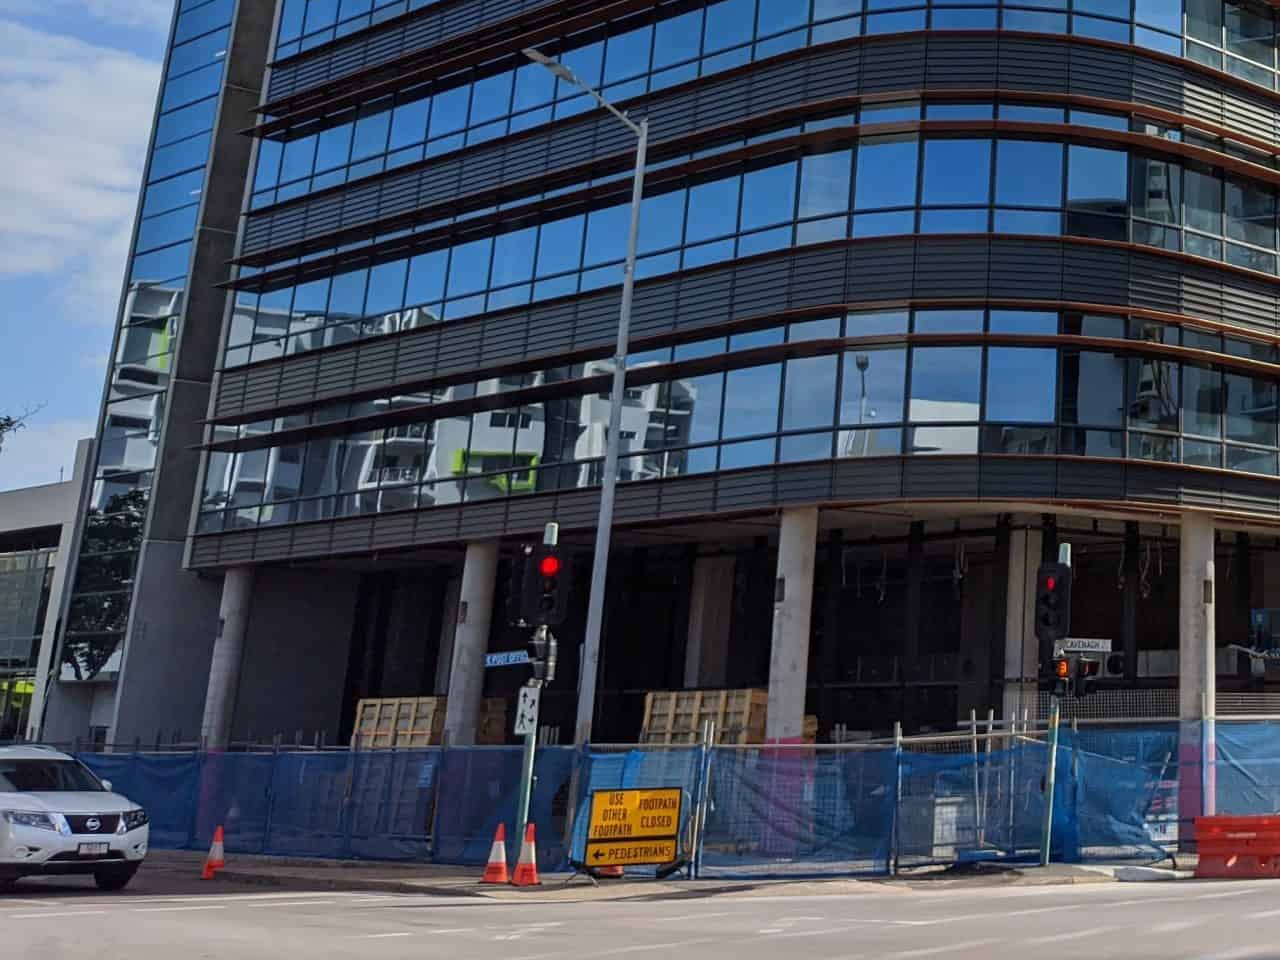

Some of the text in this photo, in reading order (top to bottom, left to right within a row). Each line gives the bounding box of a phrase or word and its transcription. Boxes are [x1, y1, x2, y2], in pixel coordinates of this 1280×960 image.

[608, 792, 624, 806] USE
[639, 798, 677, 811] FOOTPATH
[603, 808, 627, 822] OTHER
[640, 815, 672, 828] CLOSED
[593, 824, 632, 837] FOOTPATH
[608, 846, 671, 860] PEDESTRIANS
